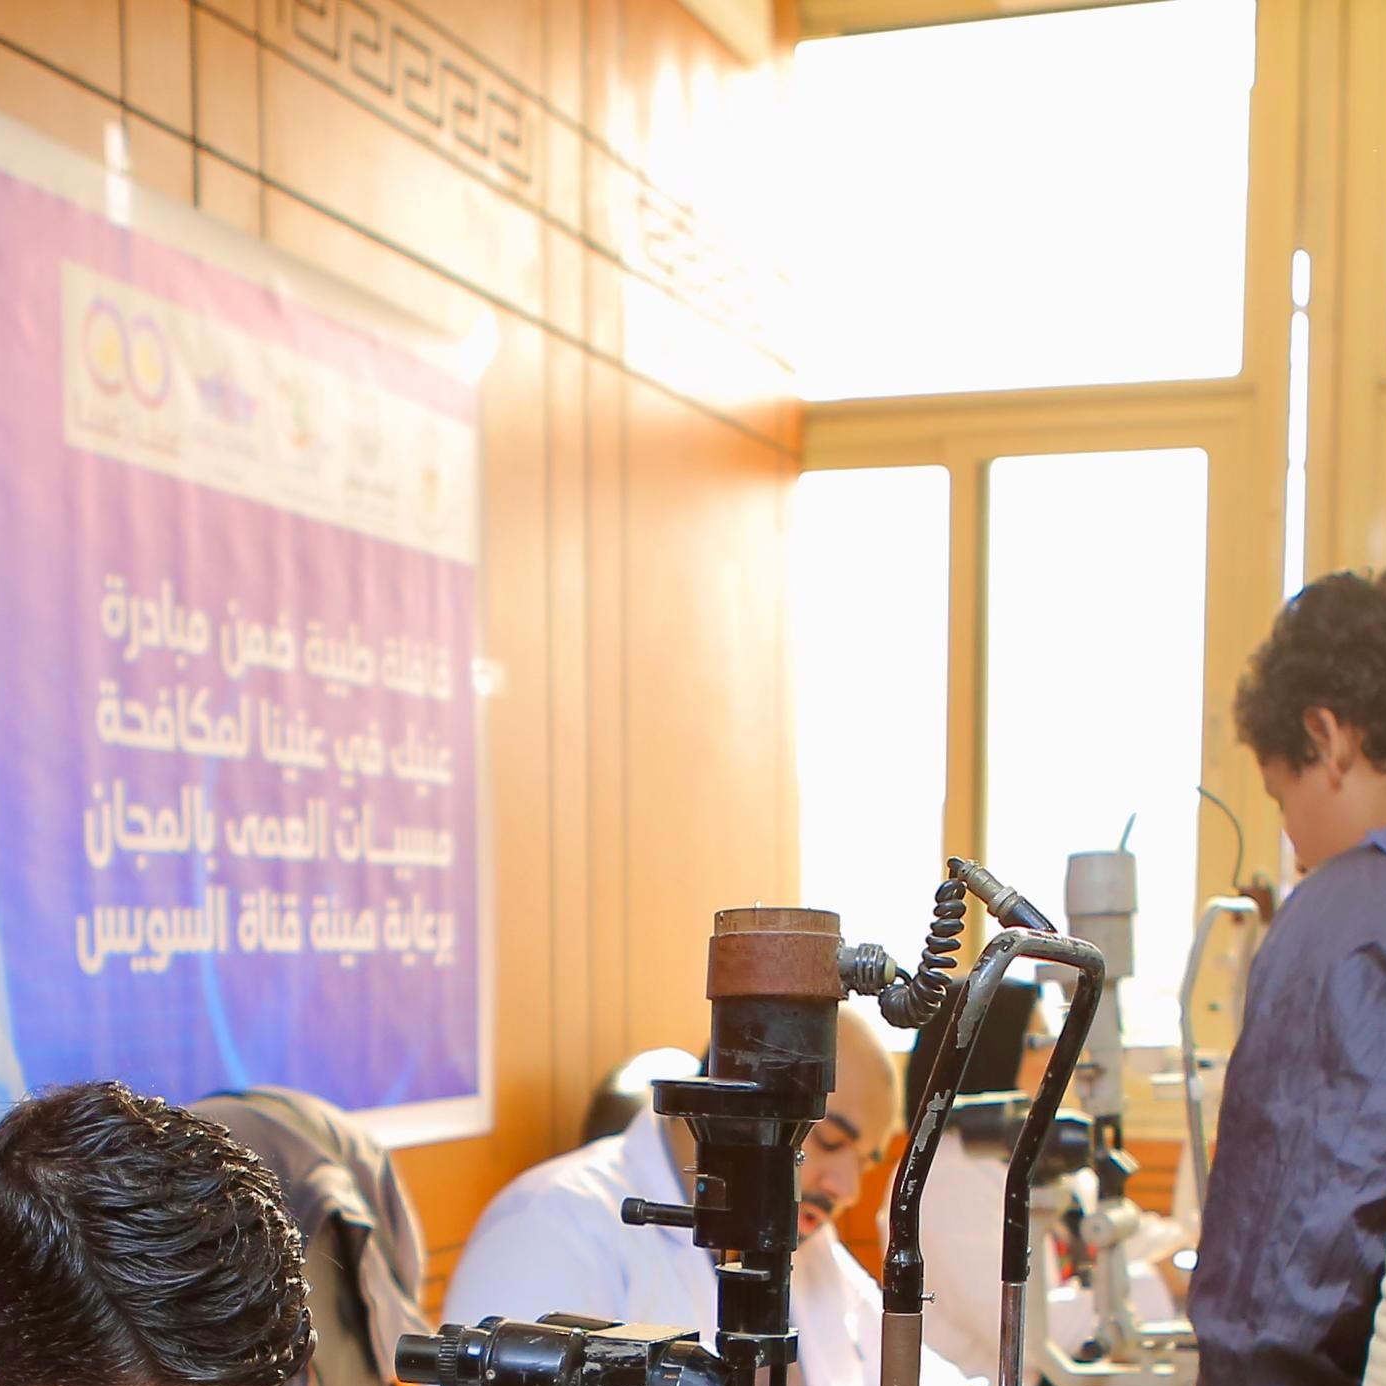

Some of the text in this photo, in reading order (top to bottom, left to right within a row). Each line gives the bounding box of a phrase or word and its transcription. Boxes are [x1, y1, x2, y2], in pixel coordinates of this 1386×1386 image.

[101, 574, 452, 700] قافلة طبية ضمن مبادرة
[96, 680, 251, 760] لمكافحة
[334, 719, 385, 788] في
[84, 779, 454, 881] مسببات العمى بالمجان
[75, 884, 229, 975] السويس
[237, 887, 302, 953] قناة
[382, 894, 455, 967] برعاية
